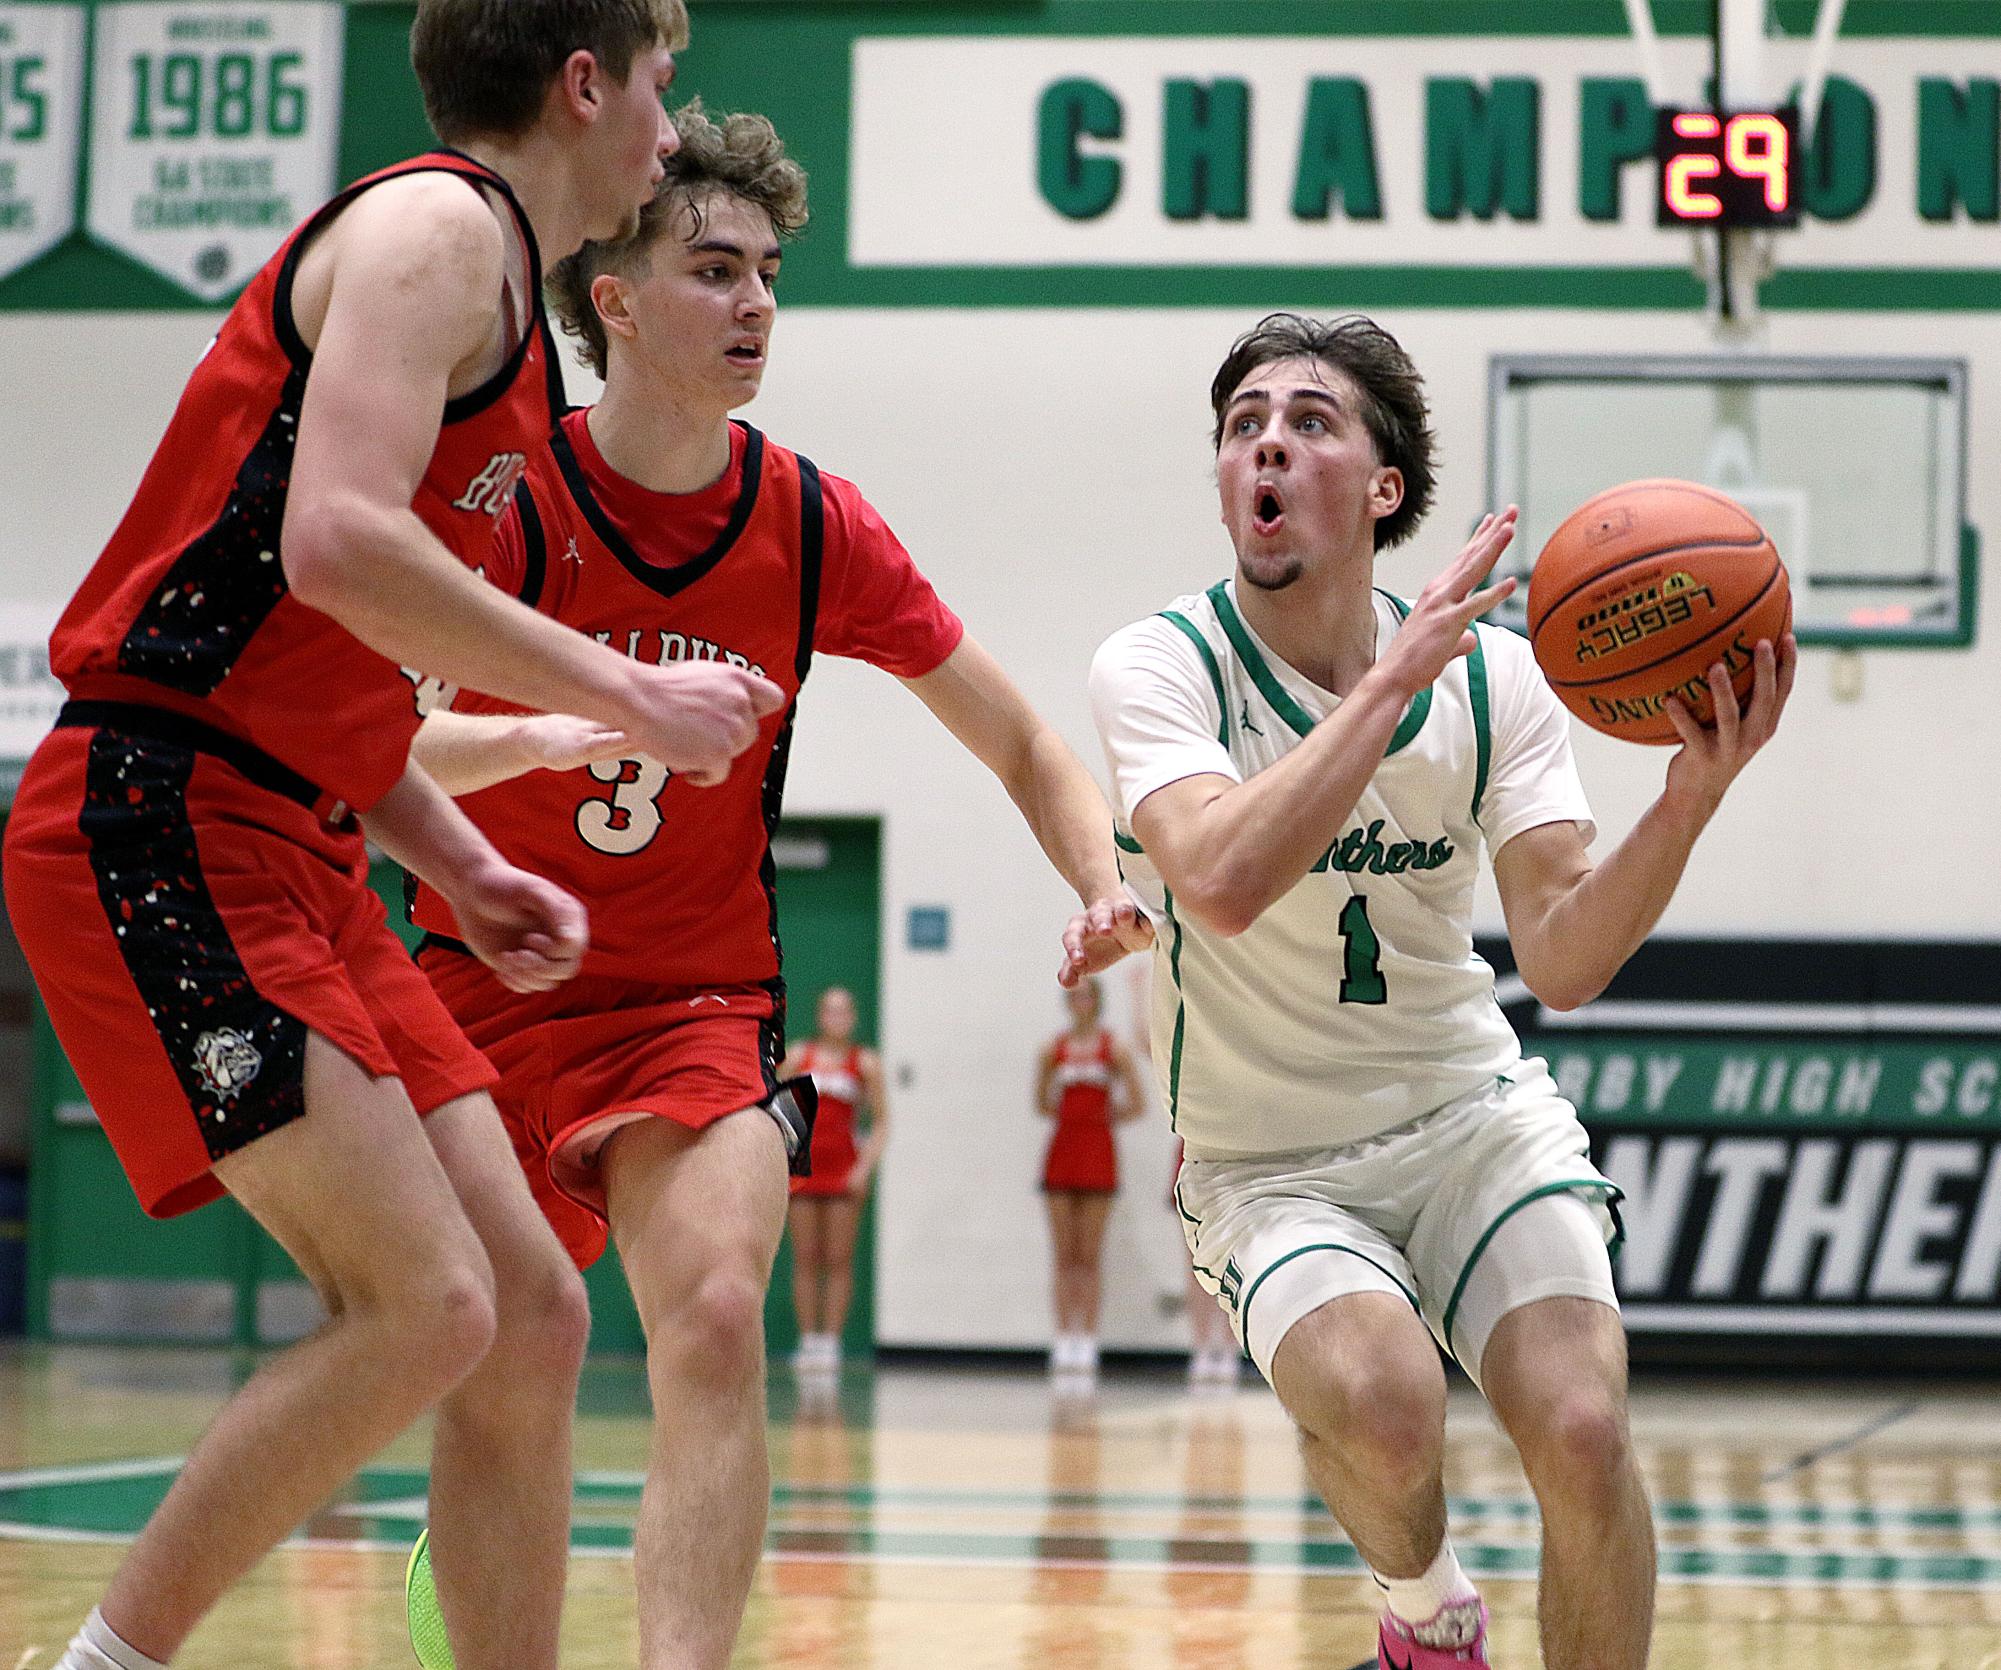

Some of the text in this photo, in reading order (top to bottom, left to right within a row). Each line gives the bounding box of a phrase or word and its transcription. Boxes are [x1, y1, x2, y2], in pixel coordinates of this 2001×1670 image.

[0, 57, 46, 141] 5
[129, 53, 305, 140] 1986
[1035, 75, 2001, 222] CHAMPON
[1665, 111, 1789, 219] 29
[1575, 584, 1716, 664] LEGACY
[574, 752, 673, 856] 3
[1338, 894, 1388, 1005] 1
[1711, 1056, 1882, 1115] HIGH
